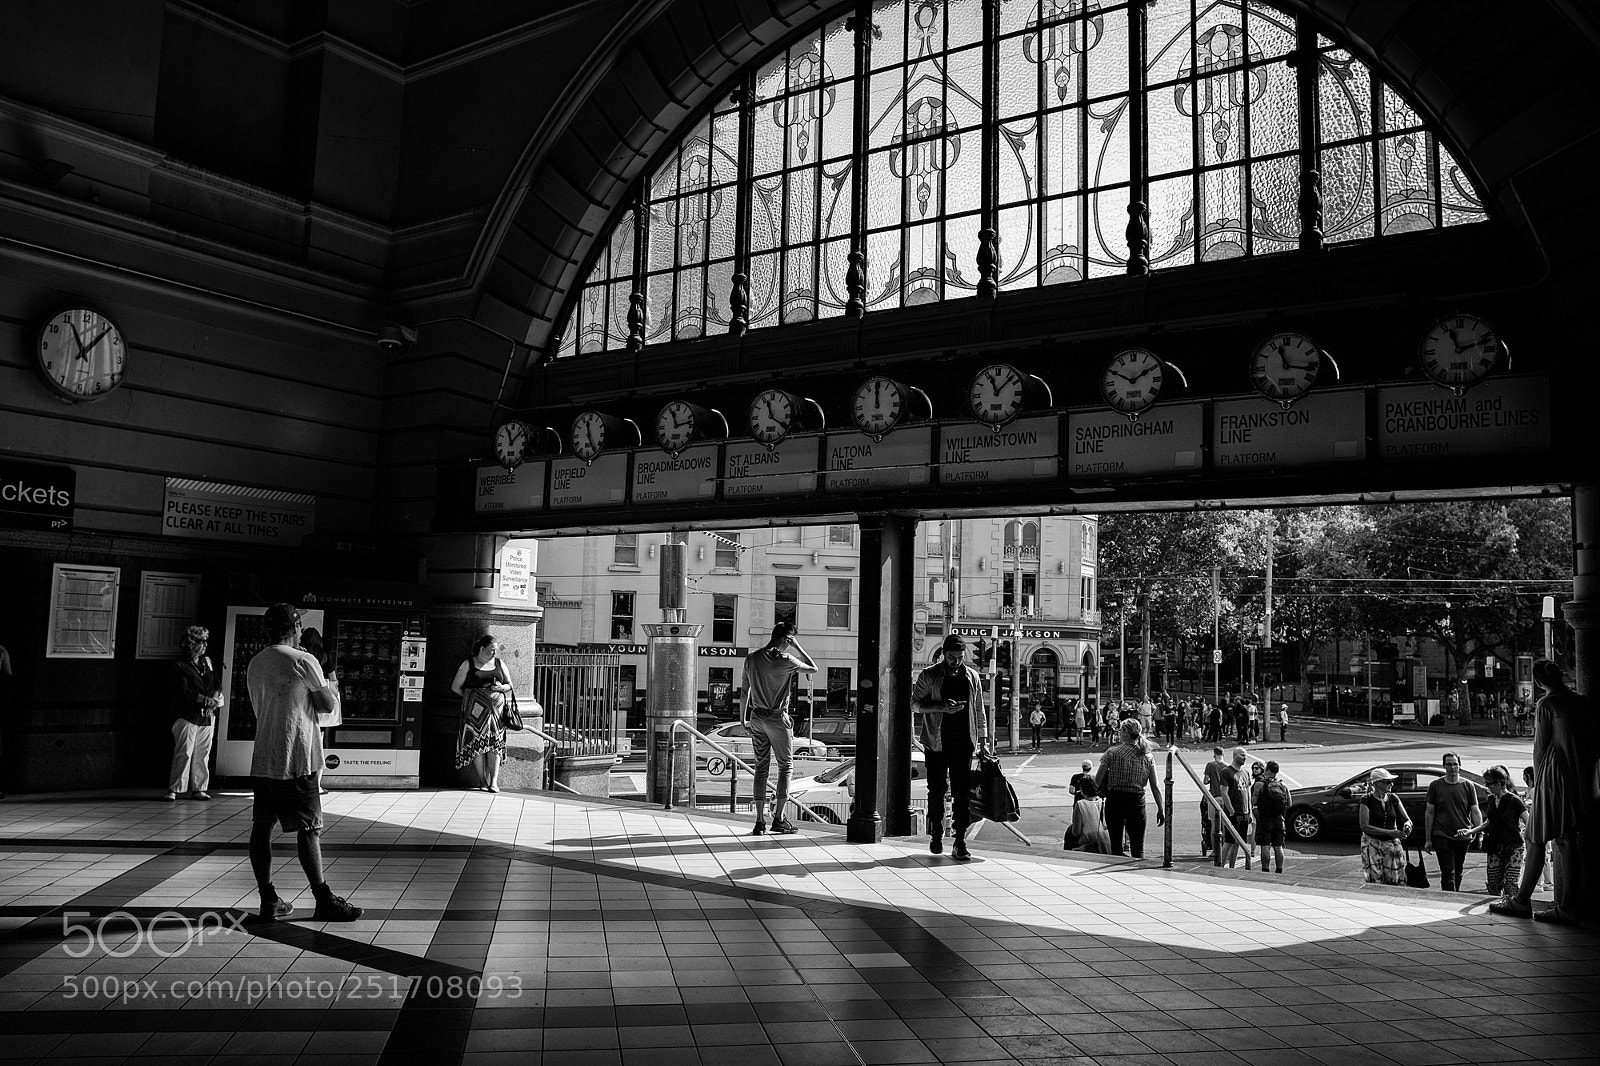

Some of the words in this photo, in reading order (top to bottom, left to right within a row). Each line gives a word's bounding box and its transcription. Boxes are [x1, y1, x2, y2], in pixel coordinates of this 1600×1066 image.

[63, 314, 70, 324] 11
[83, 314, 91, 324] 12
[49, 324, 59, 334] 10
[102, 322, 106, 331] 1
[42, 341, 48, 350] 9
[47, 361, 52, 370] 8
[60, 375, 65, 384] 7
[110, 373, 115, 382] 4
[96, 382, 101, 391] 5
[1385, 398, 1467, 418] PAKENHAM
[1475, 395, 1502, 412] and
[1220, 409, 1310, 430] FRANKSTON
[1385, 412, 1491, 434] CRANBOURNE
[1495, 408, 1540, 427] LINES
[1075, 420, 1174, 441] SANDRINGHAM
[1220, 429, 1252, 444] LINE
[946, 430, 1037, 451] WILLIAMSTOWN
[831, 444, 872, 459] ALTONA
[1075, 440, 1104, 454] LINE
[1386, 441, 1450, 455] PLATFORM
[729, 453, 742, 467] ST
[743, 451, 780, 466] ALBANS
[945, 450, 971, 464] LINE
[1221, 452, 1276, 464] PLATFORM
[637, 456, 711, 474] BROADMEADOWS
[831, 459, 854, 471] LINE
[1075, 461, 1124, 473] PLATFORM
[554, 467, 586, 480] UPFIELD
[729, 465, 750, 478] LINE
[945, 470, 989, 481] PLATFORM
[480, 474, 516, 486] WERRIBEE
[553, 479, 571, 490] LINE
[637, 473, 655, 485] LINE
[830, 478, 870, 488] PLATFORM
[0, 478, 70, 507] ckets
[479, 486, 495, 497] LINE
[635, 490, 668, 500] PLATFORM
[728, 484, 763, 494] PLATFORM
[553, 495, 582, 505] PLATFORM
[167, 500, 211, 517] PLEASE
[214, 506, 243, 520] KEEP
[246, 509, 267, 523] THE
[269, 512, 306, 527] STAIRS
[166, 516, 203, 530] CLEAR
[206, 519, 221, 532] AT
[223, 522, 244, 535] ALL
[247, 524, 279, 538] TIMES
[366, 598, 413, 606] REFRESHED
[951, 628, 987, 636] OUNG
[1002, 629, 1061, 638] JAKSON
[608, 644, 646, 653] YOUN
[700, 647, 737, 656] KSON
